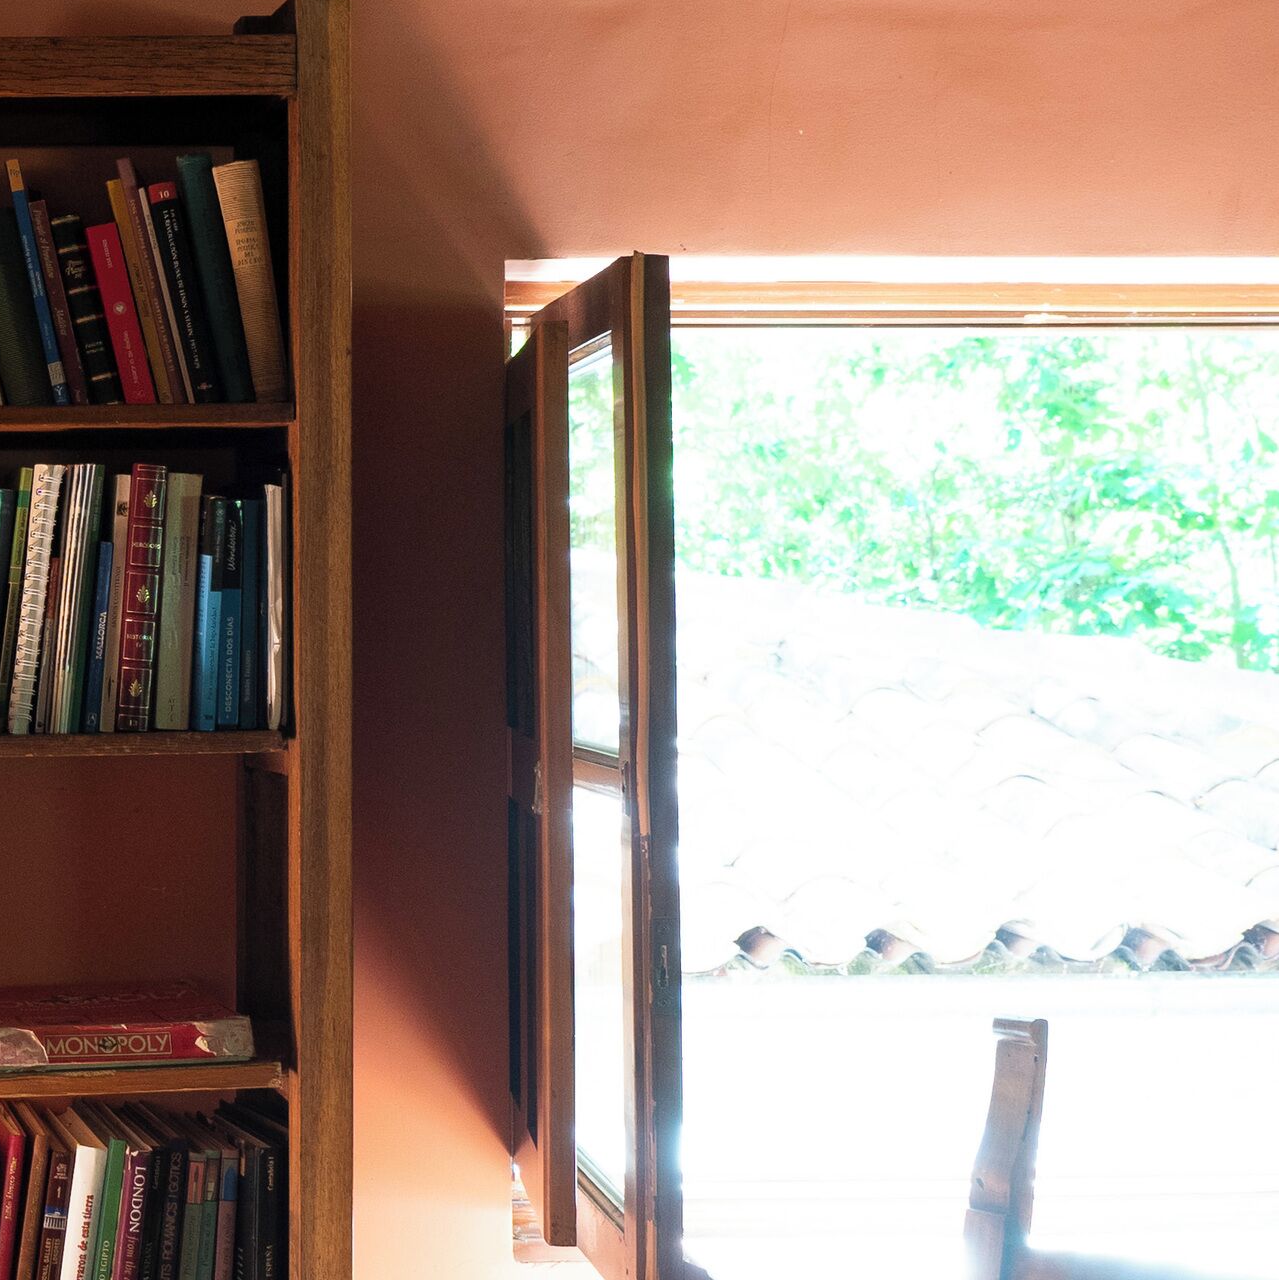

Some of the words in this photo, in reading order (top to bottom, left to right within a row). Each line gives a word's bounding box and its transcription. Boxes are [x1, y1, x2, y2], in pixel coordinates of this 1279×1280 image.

[158, 190, 170, 199] 10
[94, 611, 107, 660] MALLORCA
[223, 616, 234, 636] DÍAS
[224, 637, 233, 656] DOS
[224, 657, 233, 712] DESCONECTA
[45, 1034, 168, 1055] MONOPOLY
[168, 1152, 182, 1192] GOTICS
[80, 1194, 94, 1219] tierra
[129, 1166, 146, 1233] LONDON
[79, 1220, 90, 1238] esta
[162, 1202, 178, 1261] ROMANICS
[42, 1237, 52, 1263] GALLERY
[76, 1240, 87, 1250] de
[100, 1240, 110, 1272] EGIPTO
[125, 1235, 137, 1258] from
[124, 1260, 135, 1276] the
[144, 1242, 153, 1274] ESPAÑA
[264, 1244, 273, 1278] ESPAÑA
